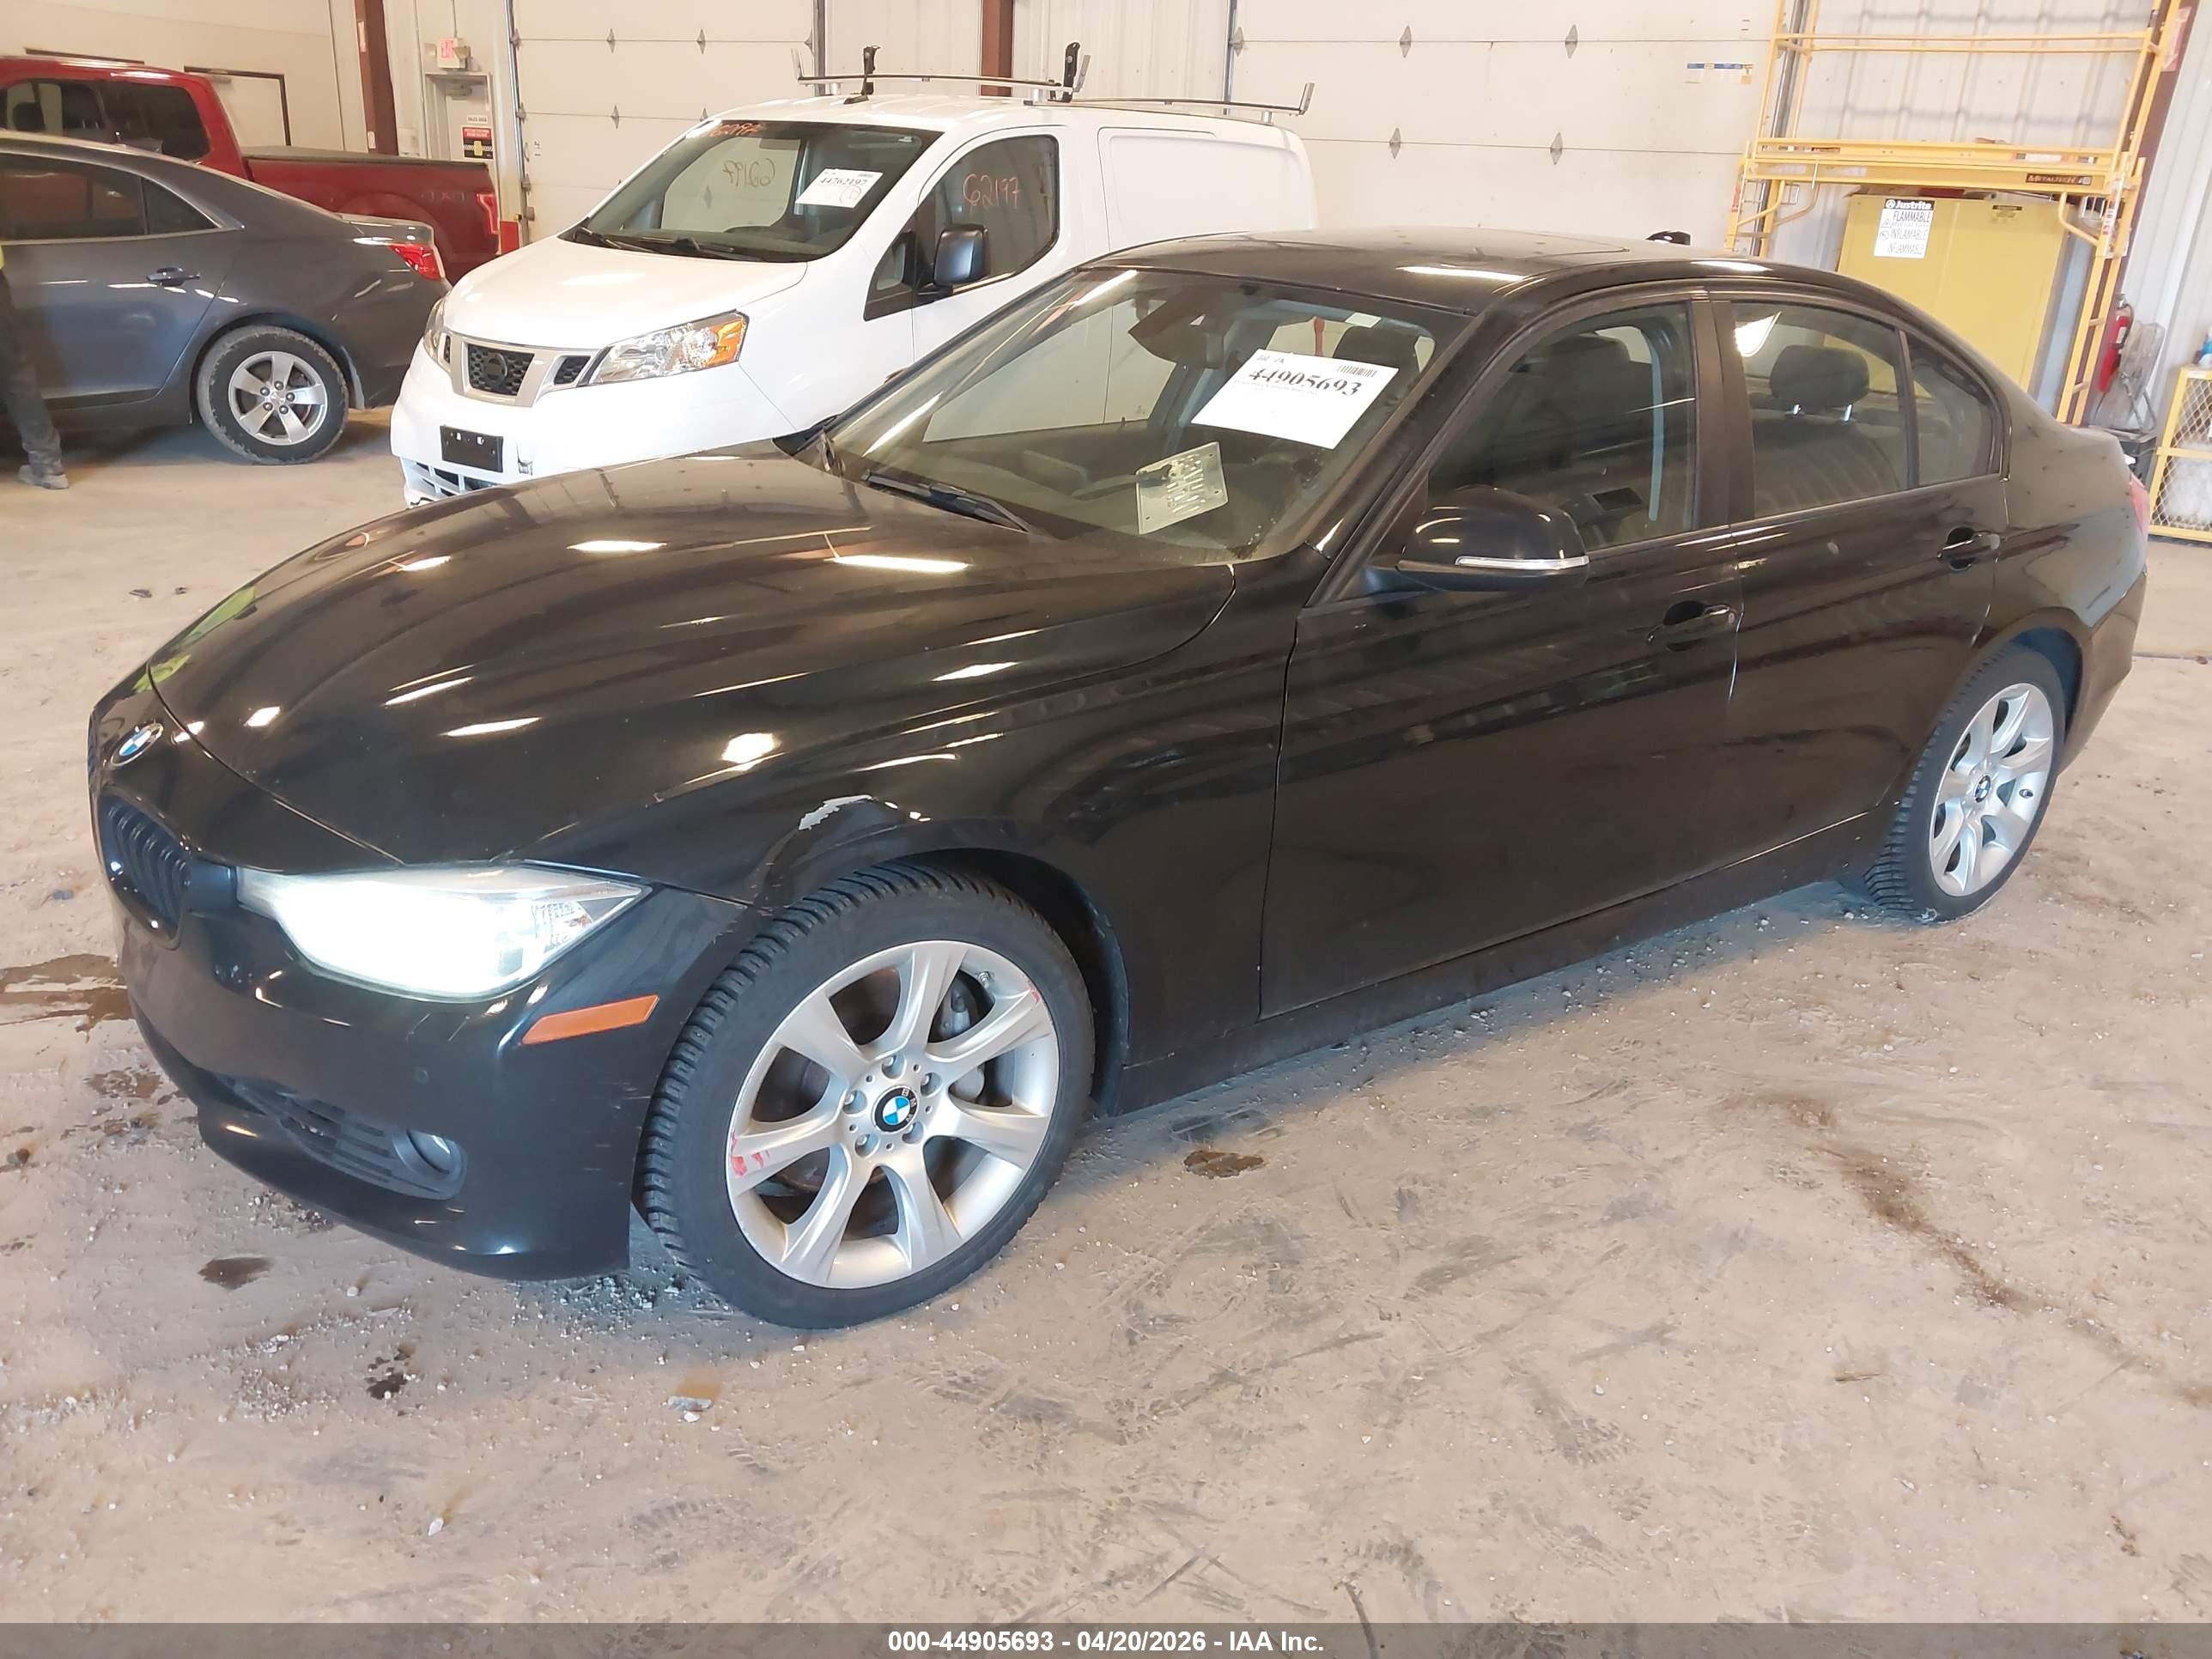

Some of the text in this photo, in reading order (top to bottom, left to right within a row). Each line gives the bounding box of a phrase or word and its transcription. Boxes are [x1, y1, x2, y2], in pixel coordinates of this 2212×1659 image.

[1894, 200, 1932, 210] Justrite
[1893, 210, 1932, 222] FLAMMABLE
[1249, 367, 1363, 397] 44905693
